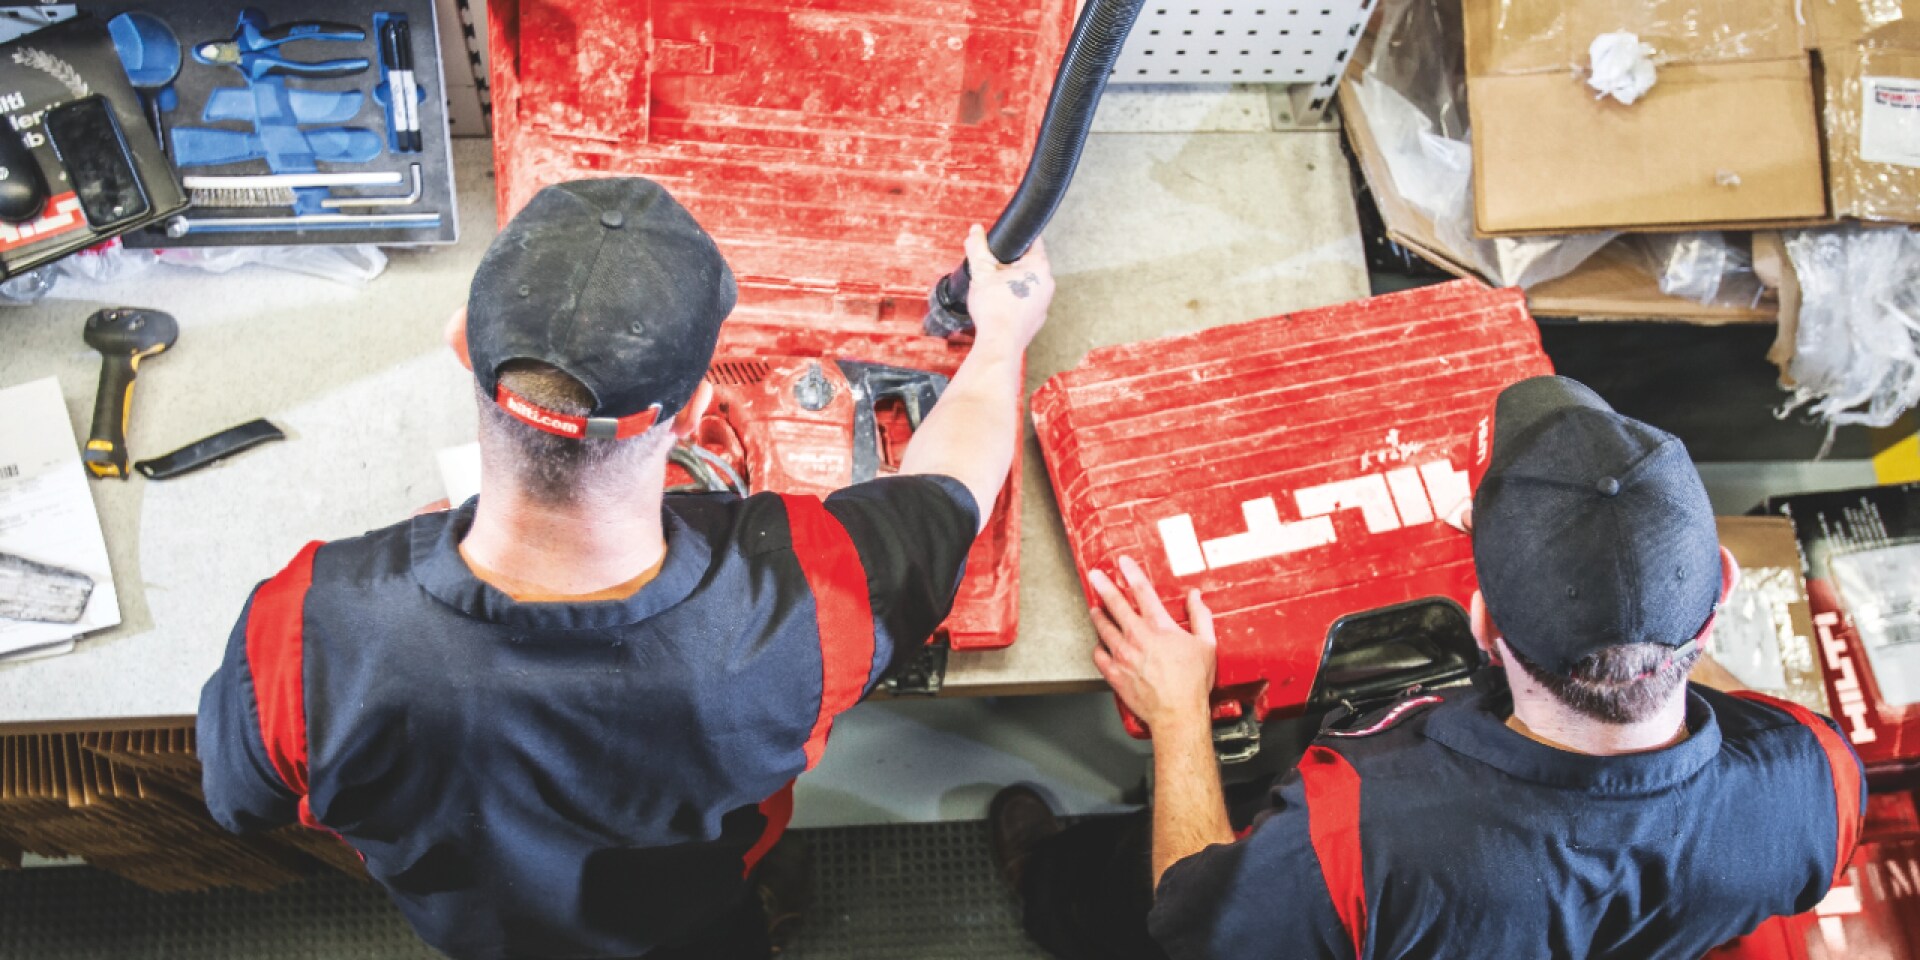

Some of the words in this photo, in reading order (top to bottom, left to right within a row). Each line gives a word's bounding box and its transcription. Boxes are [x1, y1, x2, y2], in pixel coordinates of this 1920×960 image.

[506, 396, 579, 434] hilti.com
[1476, 415, 1489, 466] HILTI
[1814, 611, 1877, 745] HILTI
